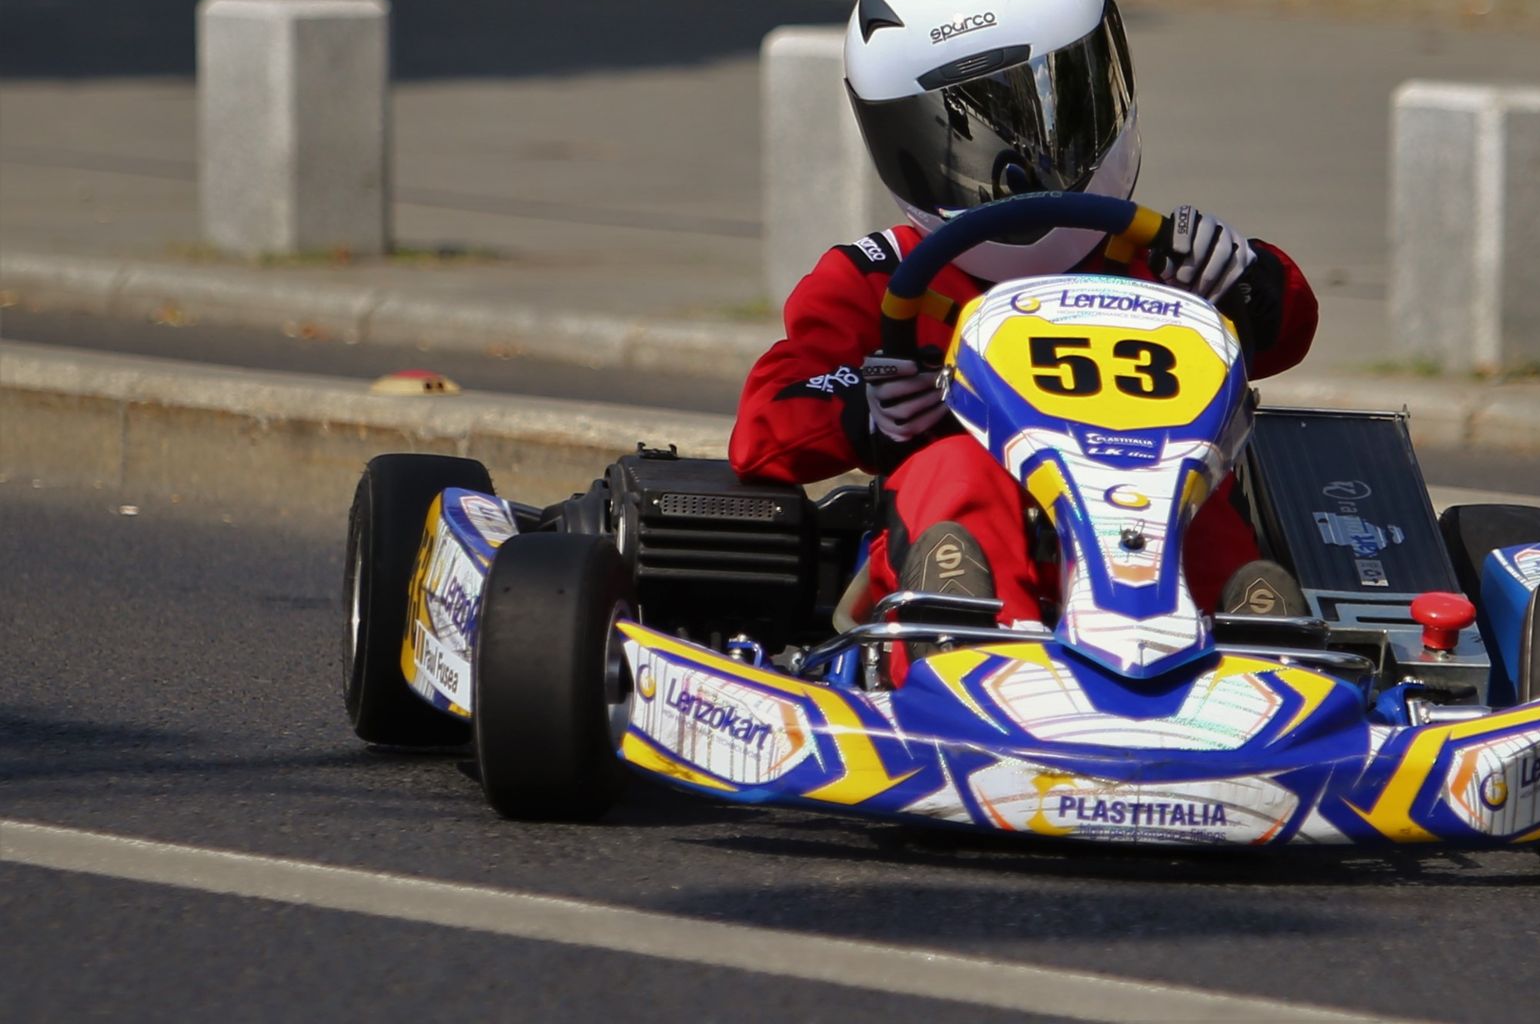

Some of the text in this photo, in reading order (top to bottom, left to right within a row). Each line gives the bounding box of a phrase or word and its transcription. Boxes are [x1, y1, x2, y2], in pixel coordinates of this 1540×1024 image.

[929, 11, 997, 44] sparco
[1060, 289, 1183, 318] Lenzokart
[1028, 336, 1181, 400] 53
[422, 638, 460, 694] Paul Fusea
[665, 677, 773, 751] Lenzokart
[1058, 795, 1228, 827] PLASTITALIA
